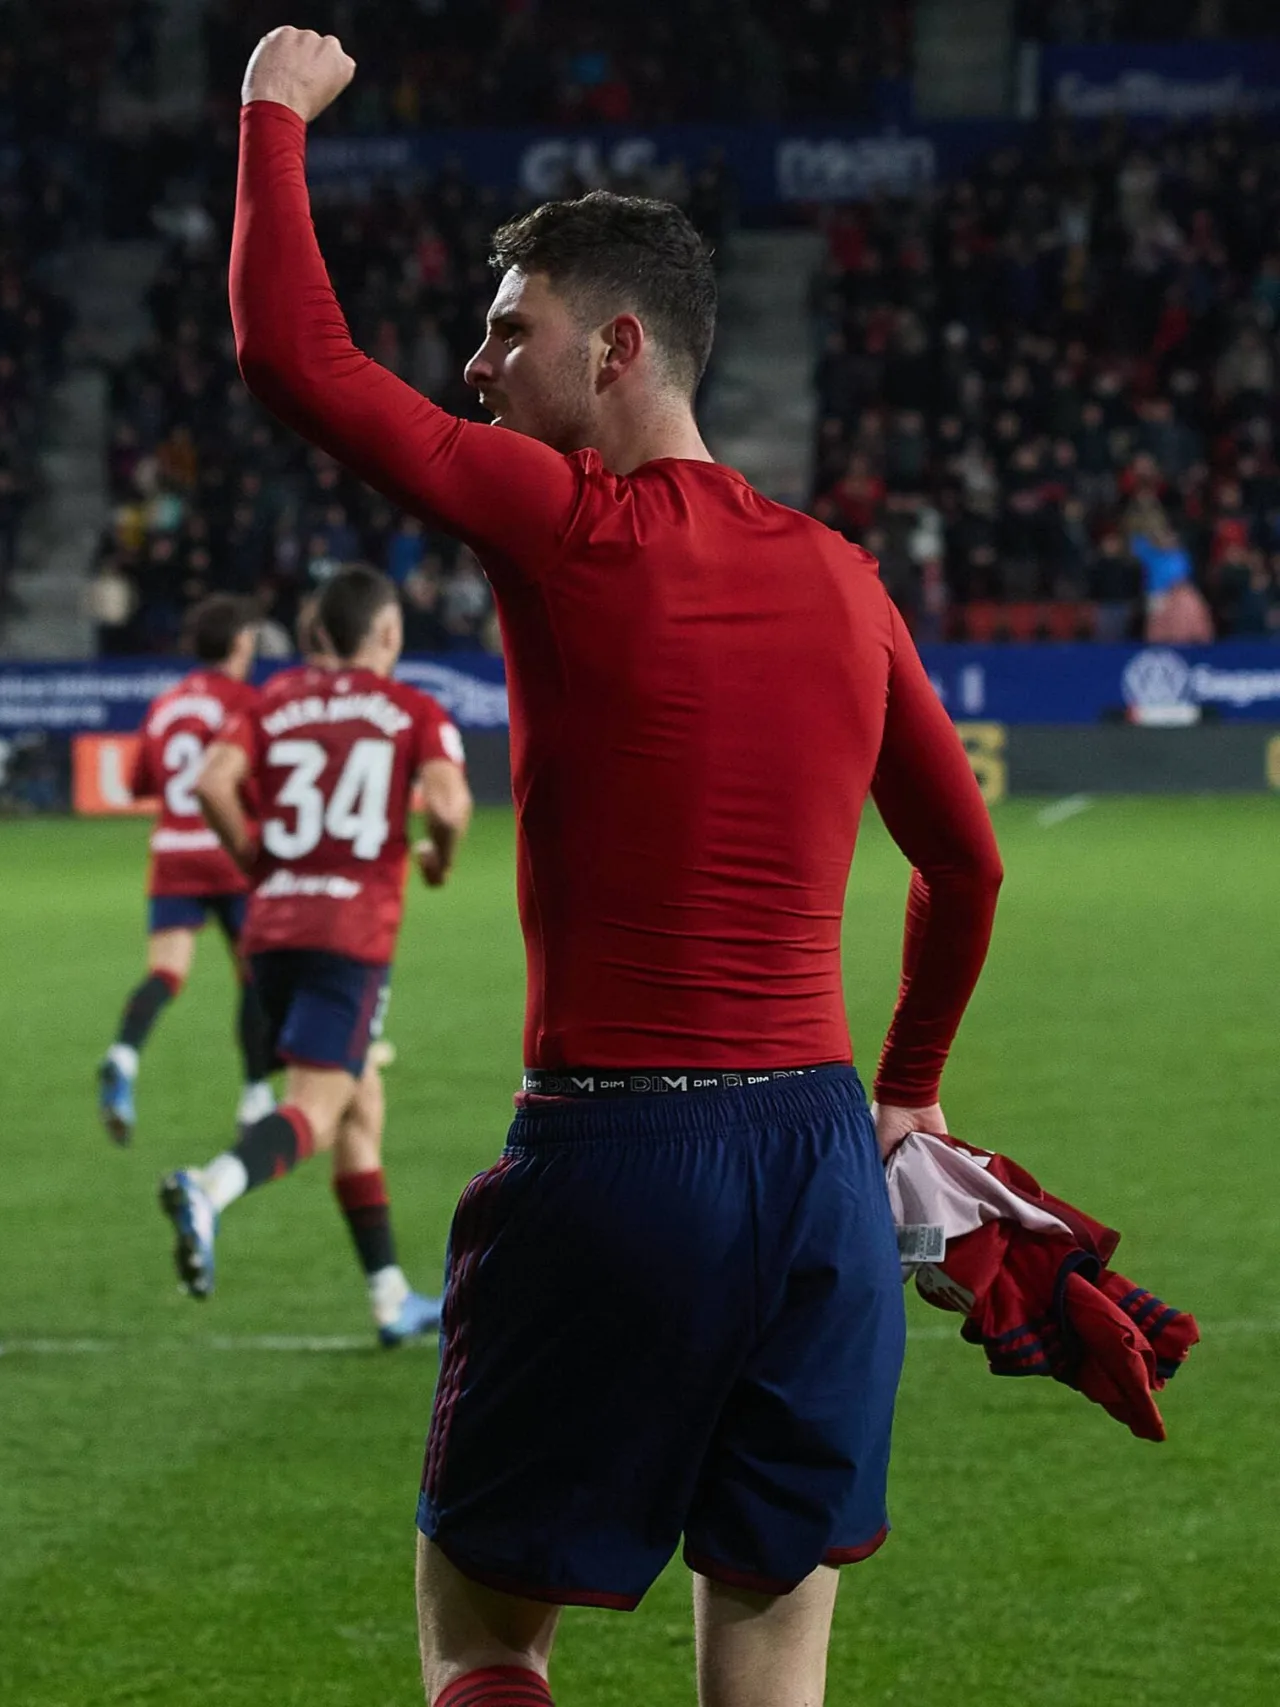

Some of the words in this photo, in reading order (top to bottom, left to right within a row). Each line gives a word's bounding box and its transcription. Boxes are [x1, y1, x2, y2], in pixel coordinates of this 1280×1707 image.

[262, 738, 396, 861] 34
[600, 1080, 625, 1088] DIM
[630, 1075, 688, 1092] DIM
[693, 1078, 718, 1088] DIM
[747, 1076, 770, 1085] DIM
